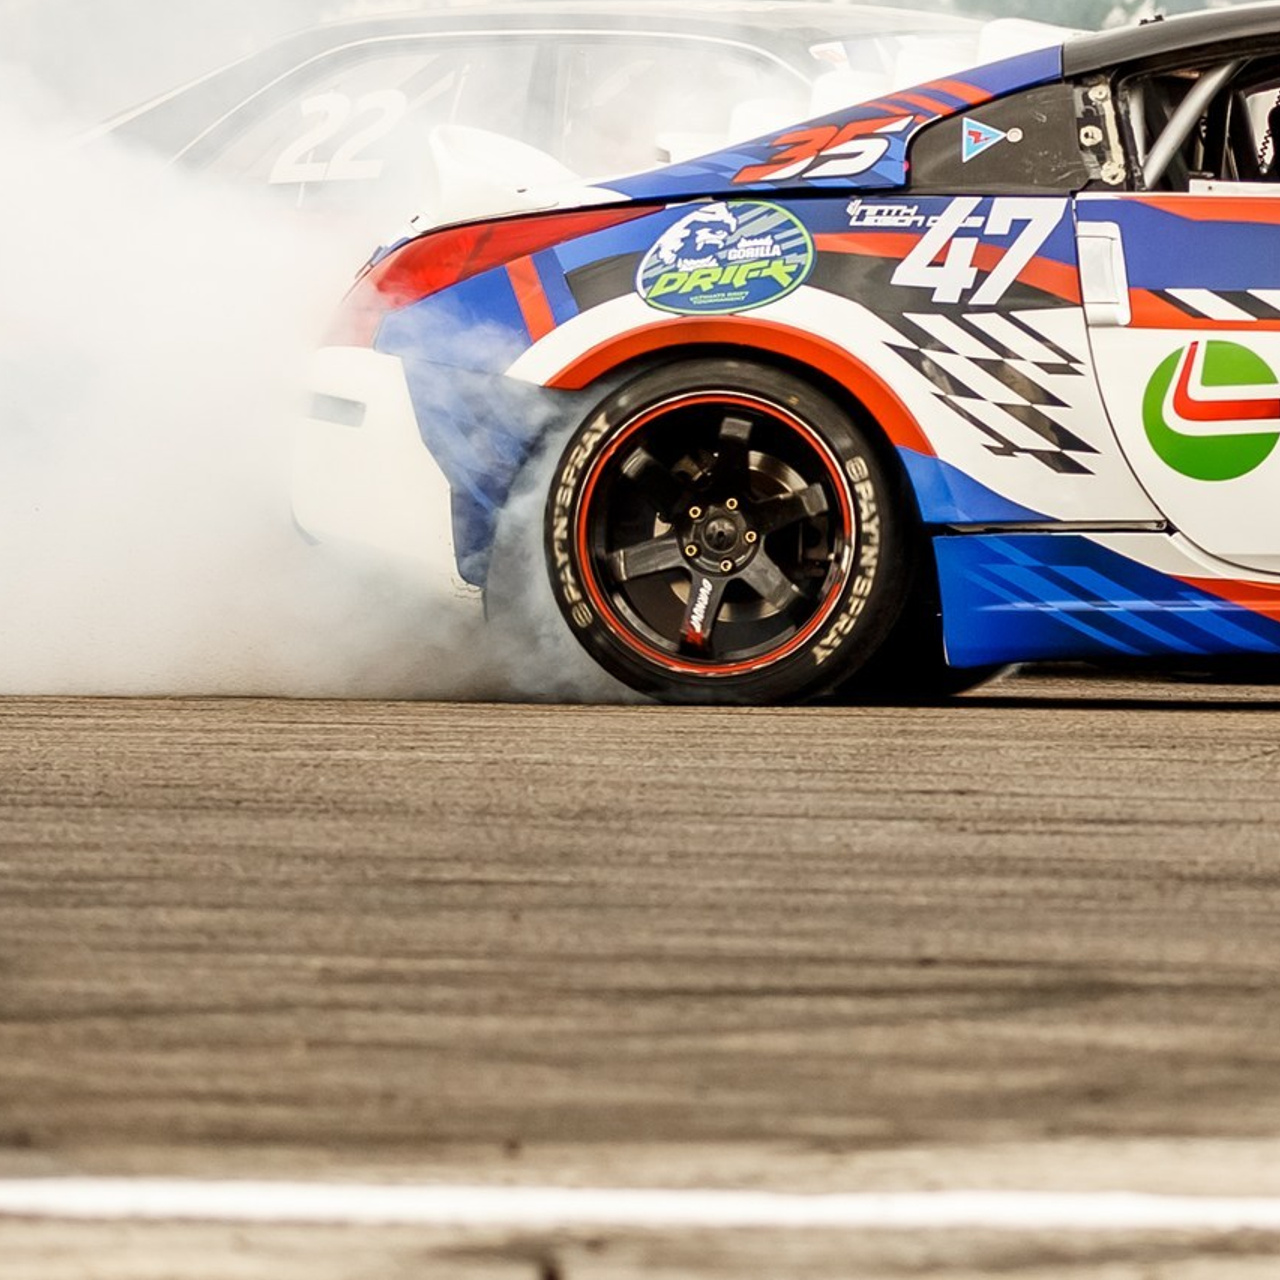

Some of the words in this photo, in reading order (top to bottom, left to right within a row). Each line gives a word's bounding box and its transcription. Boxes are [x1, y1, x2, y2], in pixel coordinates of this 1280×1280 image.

[268, 89, 407, 184] 22
[646, 259, 799, 299] DRIFT
[727, 244, 783, 261] GORILLA
[890, 197, 1068, 305] 47
